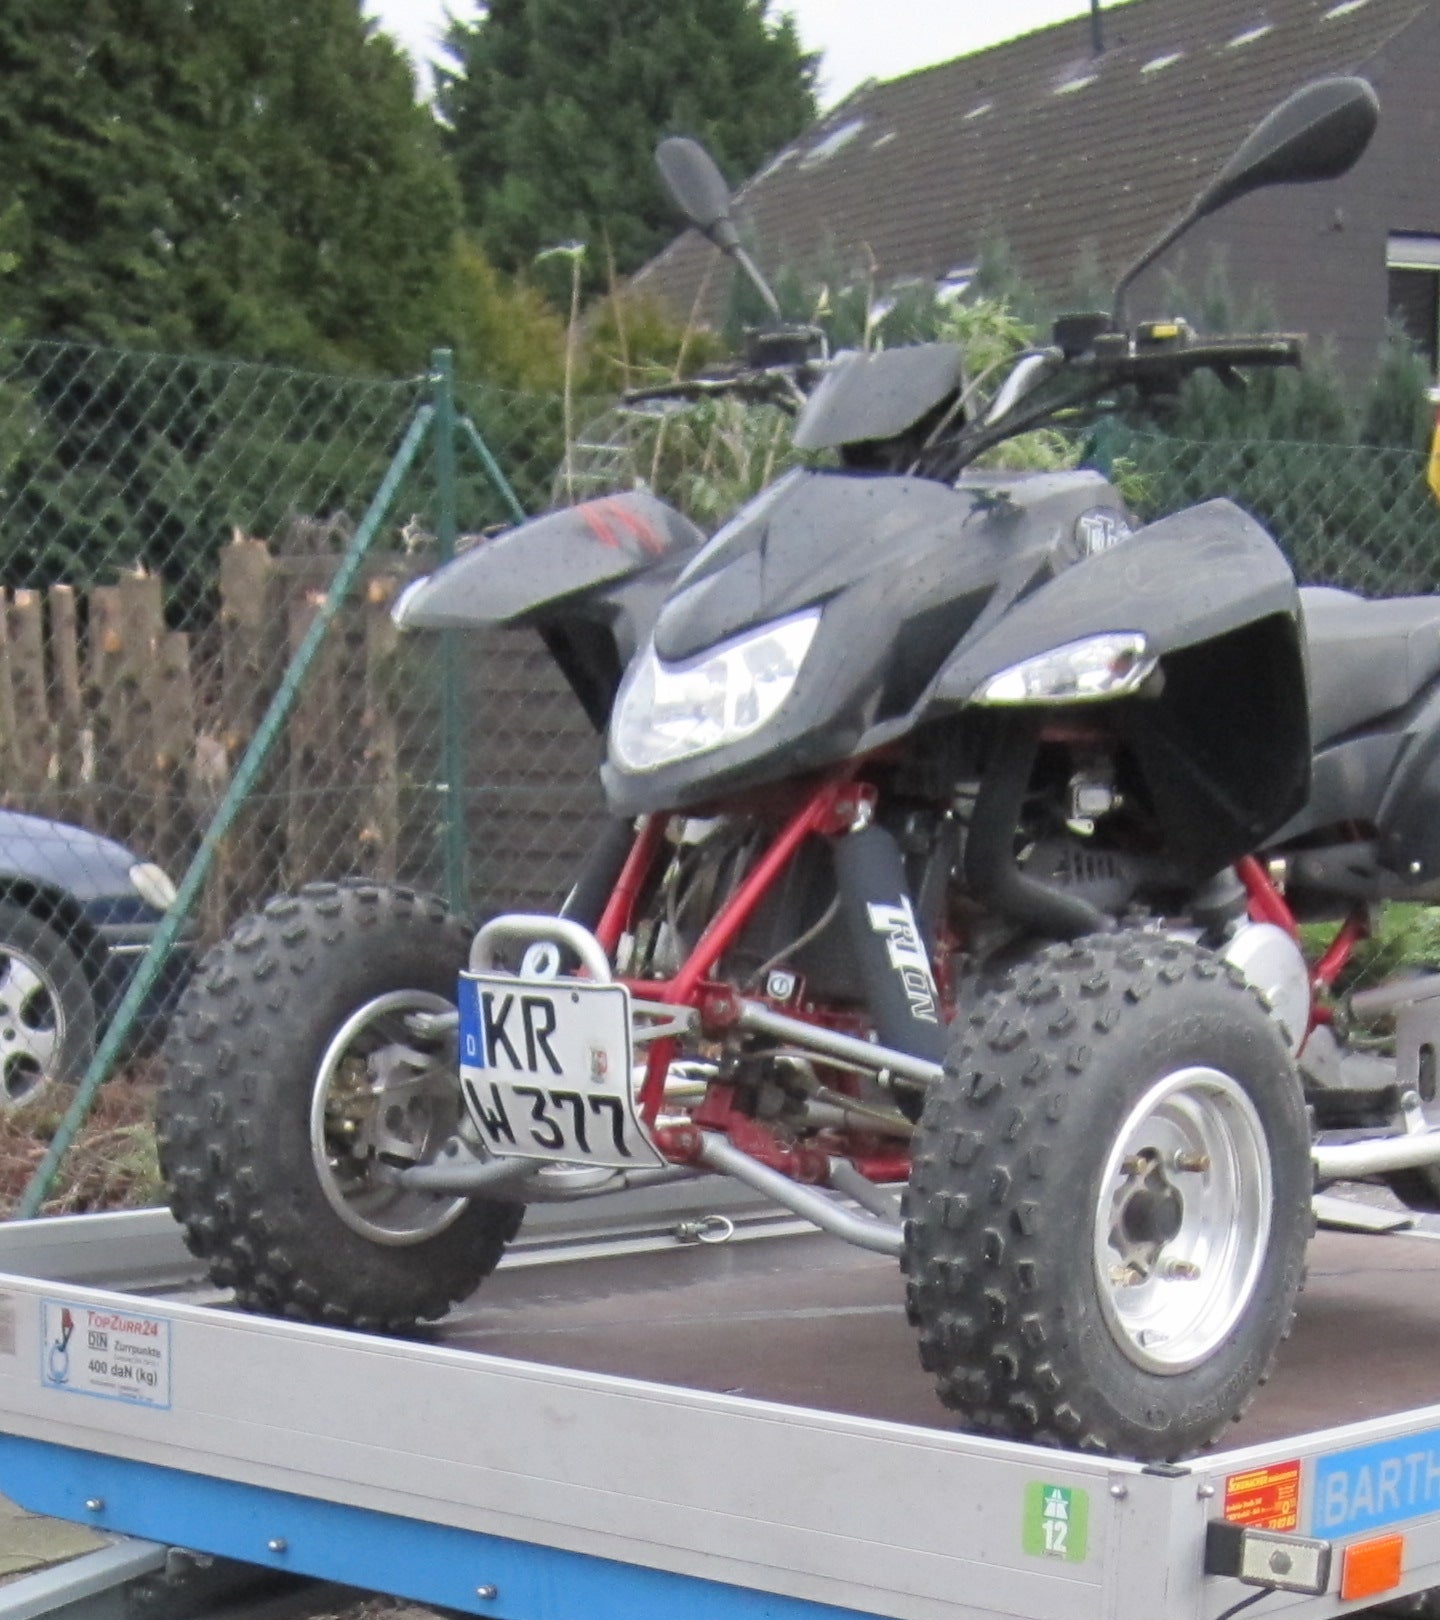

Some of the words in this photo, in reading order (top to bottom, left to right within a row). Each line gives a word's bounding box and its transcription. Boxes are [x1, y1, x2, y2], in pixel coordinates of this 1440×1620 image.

[866, 893, 938, 1023] TRITON
[466, 1034, 476, 1056] D
[482, 991, 563, 1075] KR
[465, 1078, 516, 1145] W
[512, 1085, 632, 1157] 377
[88, 1331, 108, 1351] DIN
[88, 1359, 107, 1374] 400
[111, 1364, 133, 1379] daN
[136, 1367, 158, 1386] (kg)
[1042, 1520, 1068, 1553] 12
